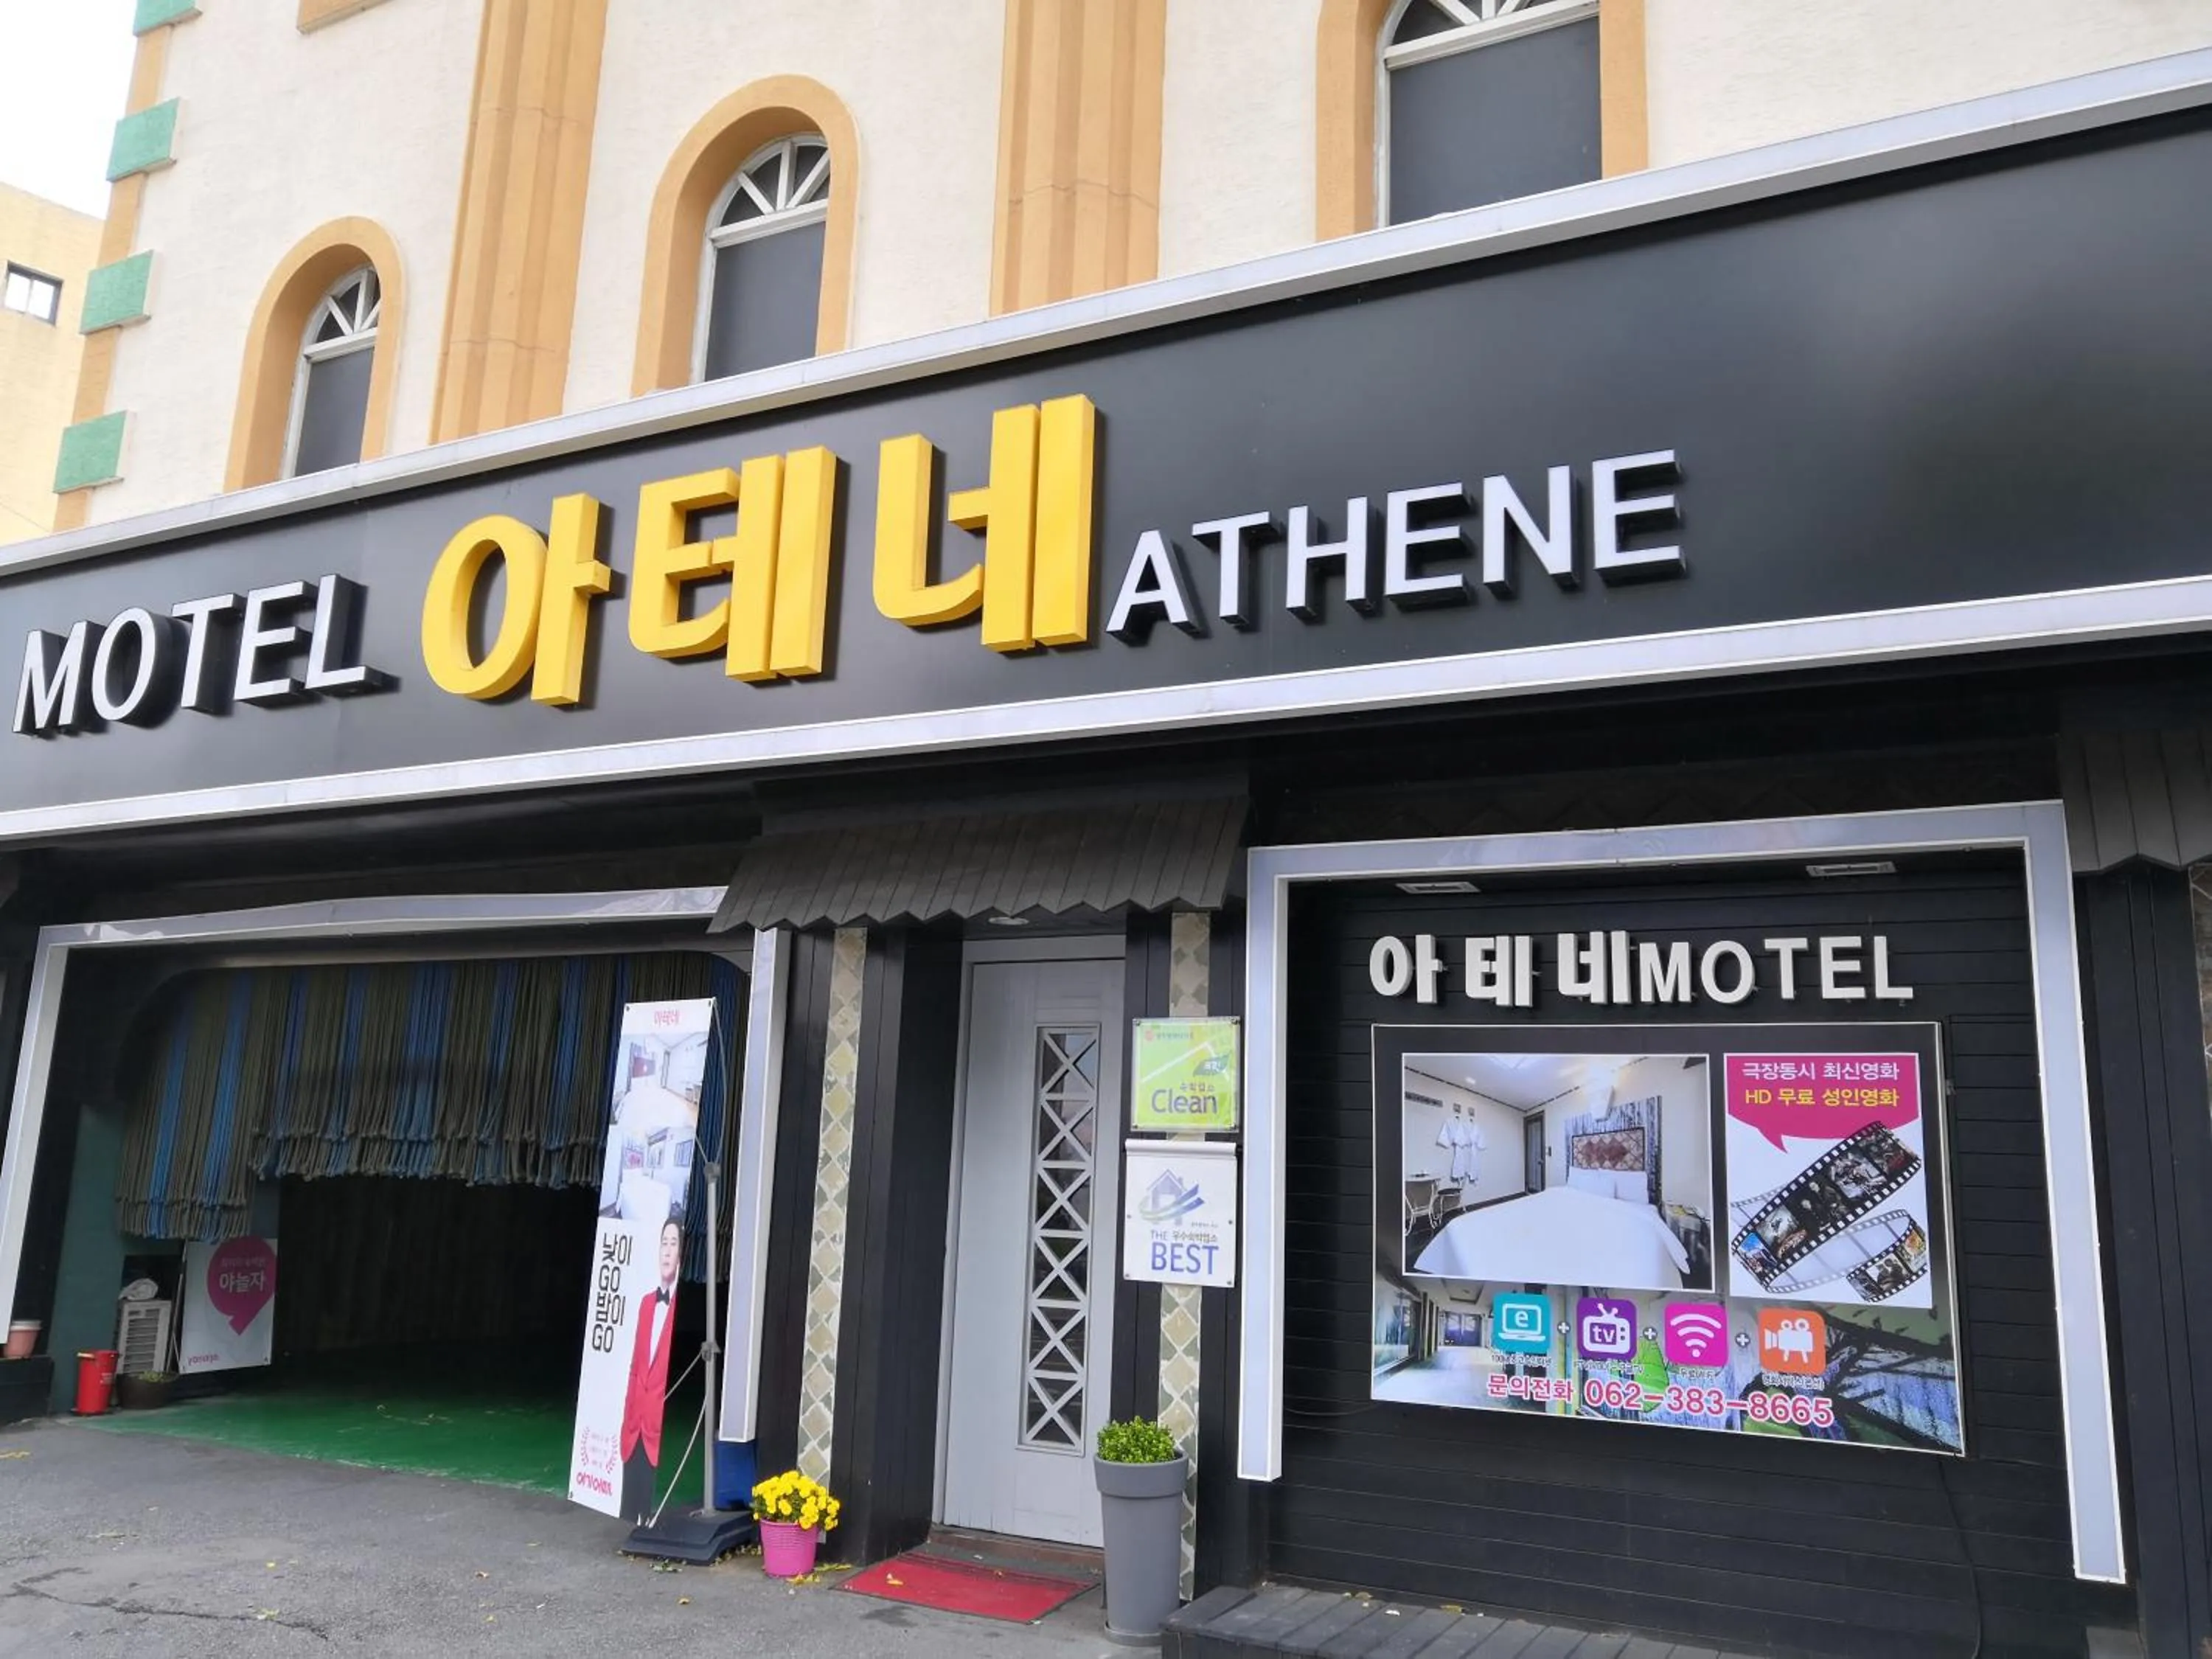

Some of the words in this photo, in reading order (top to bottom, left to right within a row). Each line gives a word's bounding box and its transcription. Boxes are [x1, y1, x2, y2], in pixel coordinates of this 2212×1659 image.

[12, 574, 375, 736] MOTEL
[421, 393, 1096, 706] 아테네
[1105, 449, 1684, 640] ATHENE
[1742, 1062, 1816, 1080] 극장동시
[1823, 1061, 1899, 1080] 최신영화
[1151, 1088, 1217, 1114] Clean
[1745, 1089, 1772, 1105] HD
[1778, 1088, 1815, 1105] 무료
[1821, 1088, 1900, 1107] 성인영화
[602, 1232, 633, 1265] 낮이
[1151, 1242, 1220, 1275] BEST
[598, 1264, 621, 1293] GO
[596, 1291, 626, 1326] 밤이
[591, 1324, 614, 1353] GO
[1592, 1324, 1615, 1343] tv
[1487, 1374, 1574, 1402] 문의전화
[1585, 1379, 1834, 1426] 062-383-8665
